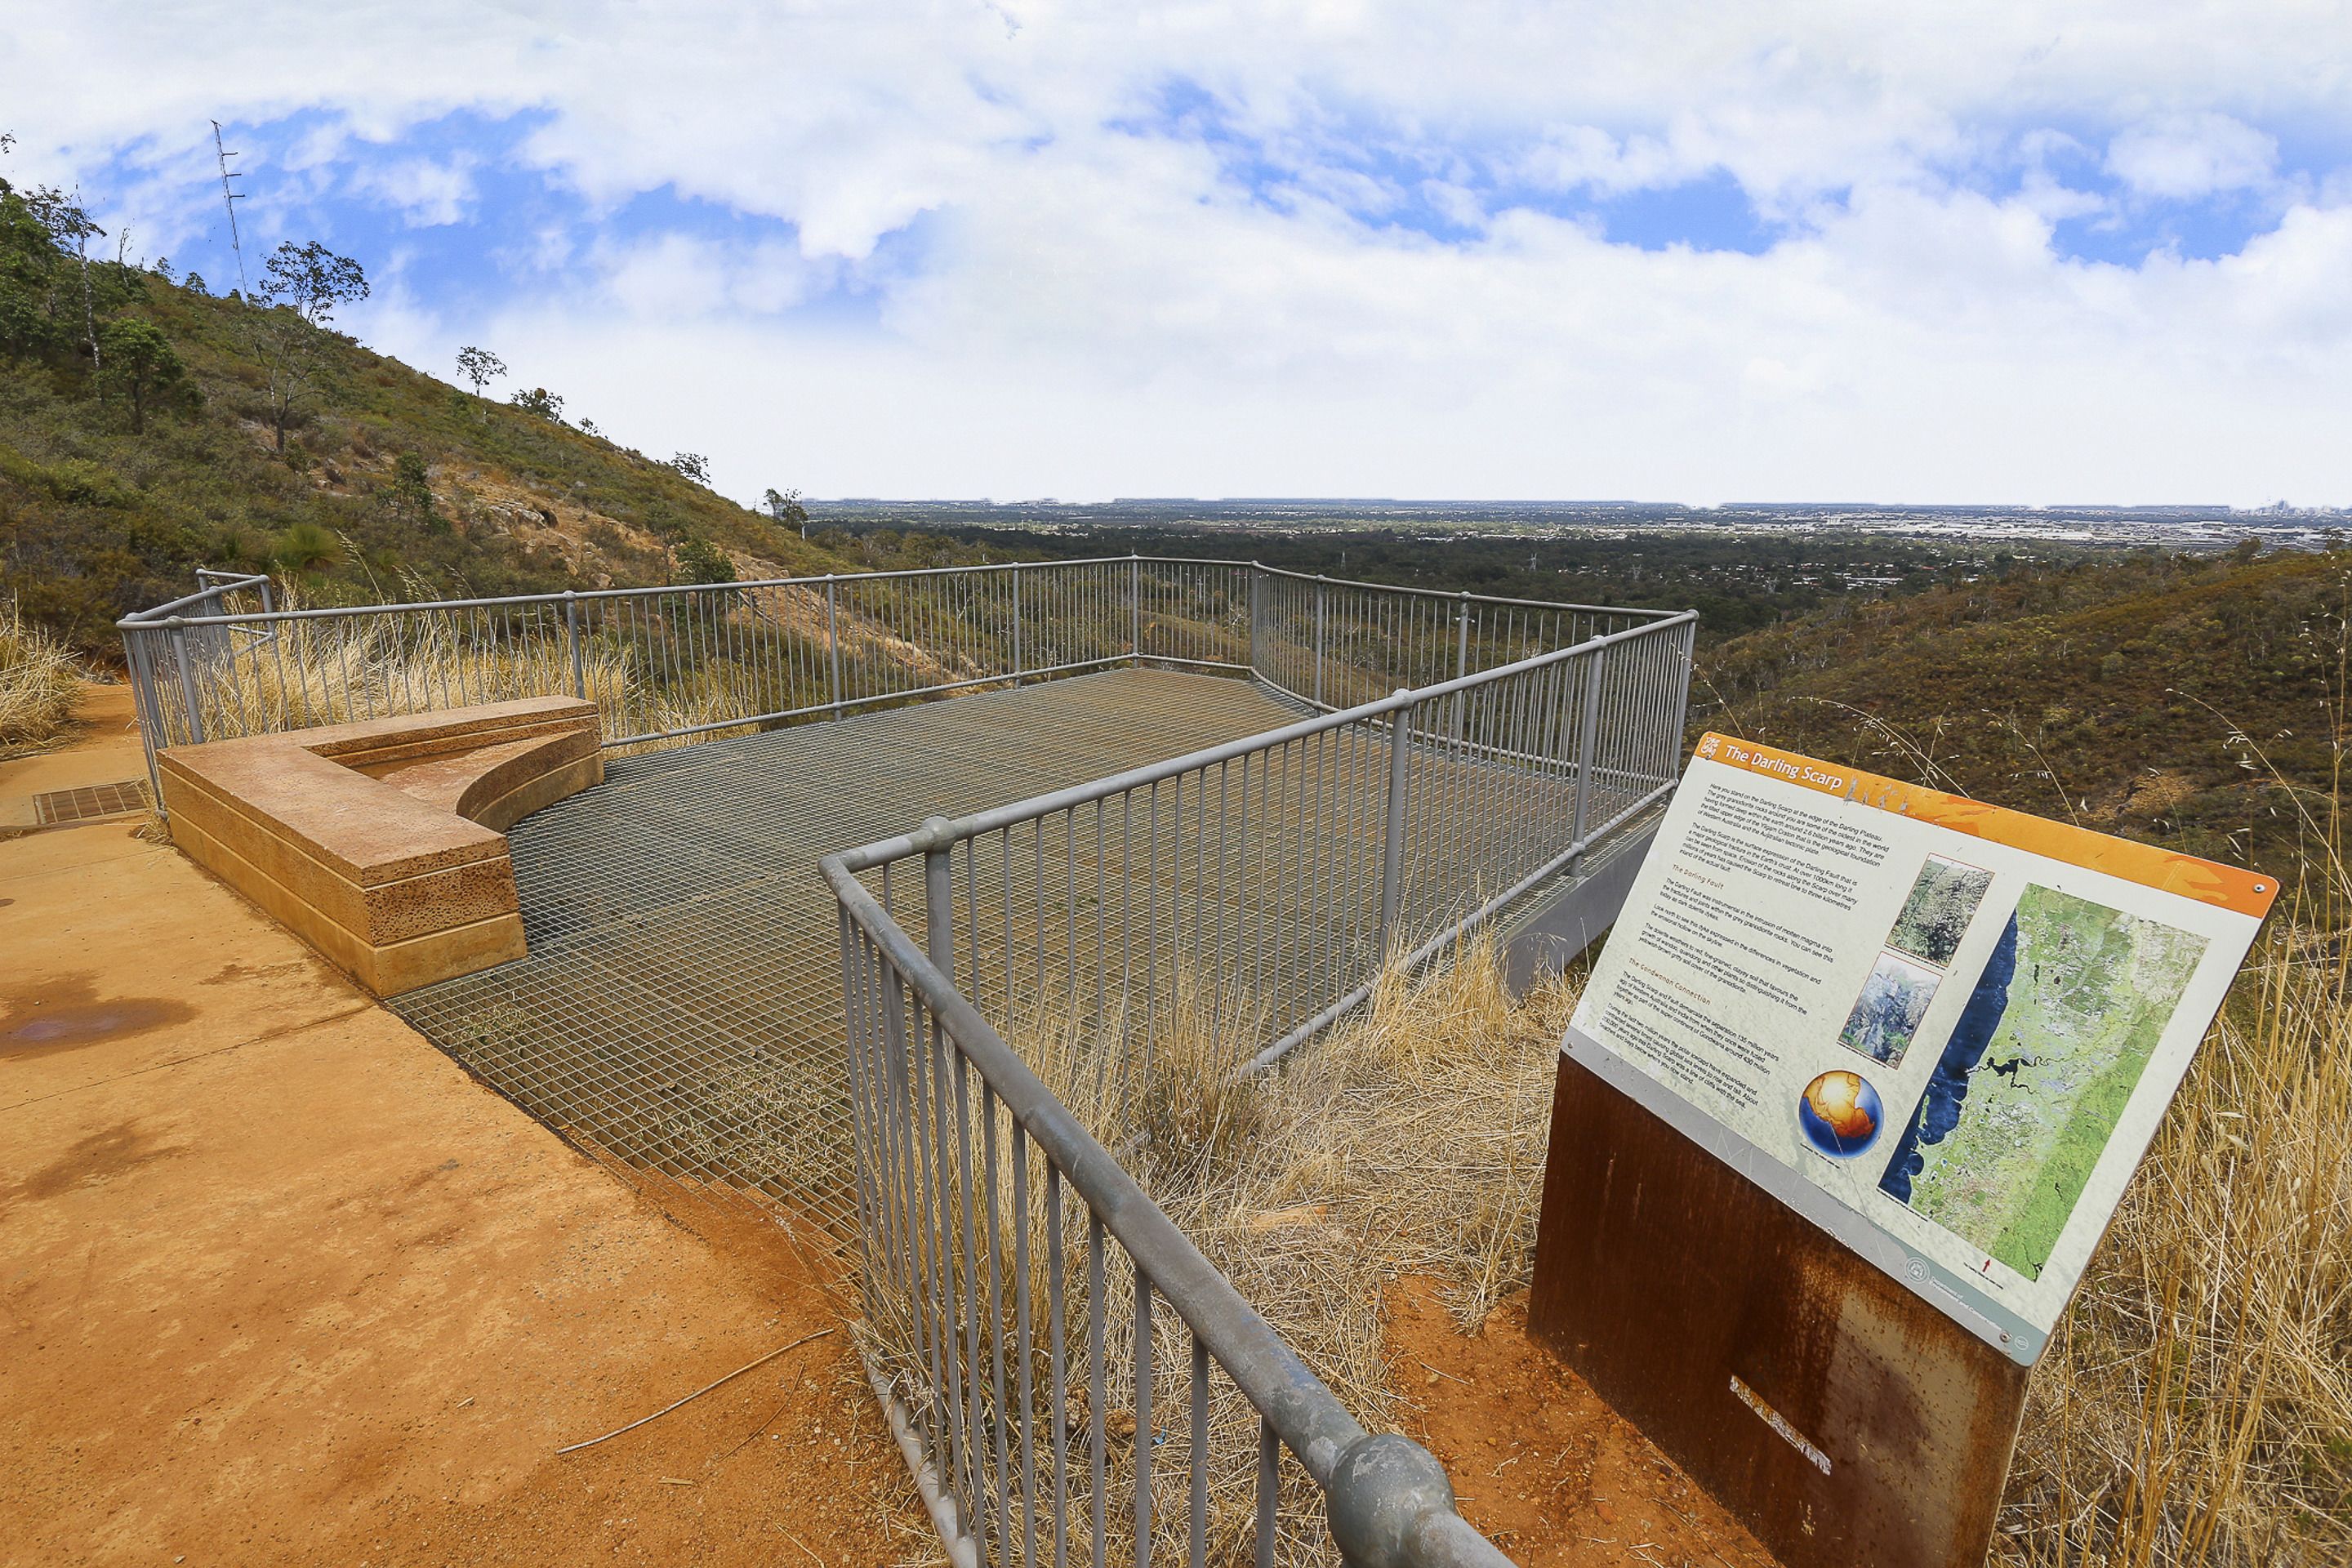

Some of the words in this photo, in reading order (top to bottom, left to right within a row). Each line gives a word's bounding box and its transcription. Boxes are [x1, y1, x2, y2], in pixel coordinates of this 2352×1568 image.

[1725, 745, 1748, 763] The
[1751, 752, 1800, 780] Darling
[1801, 766, 1843, 791] Scarp
[1671, 863, 1685, 873] The
[1682, 867, 1708, 884] Darling
[1705, 877, 1725, 890] Fault
[1628, 956, 1641, 968] The
[1673, 981, 1712, 1006] Connection
